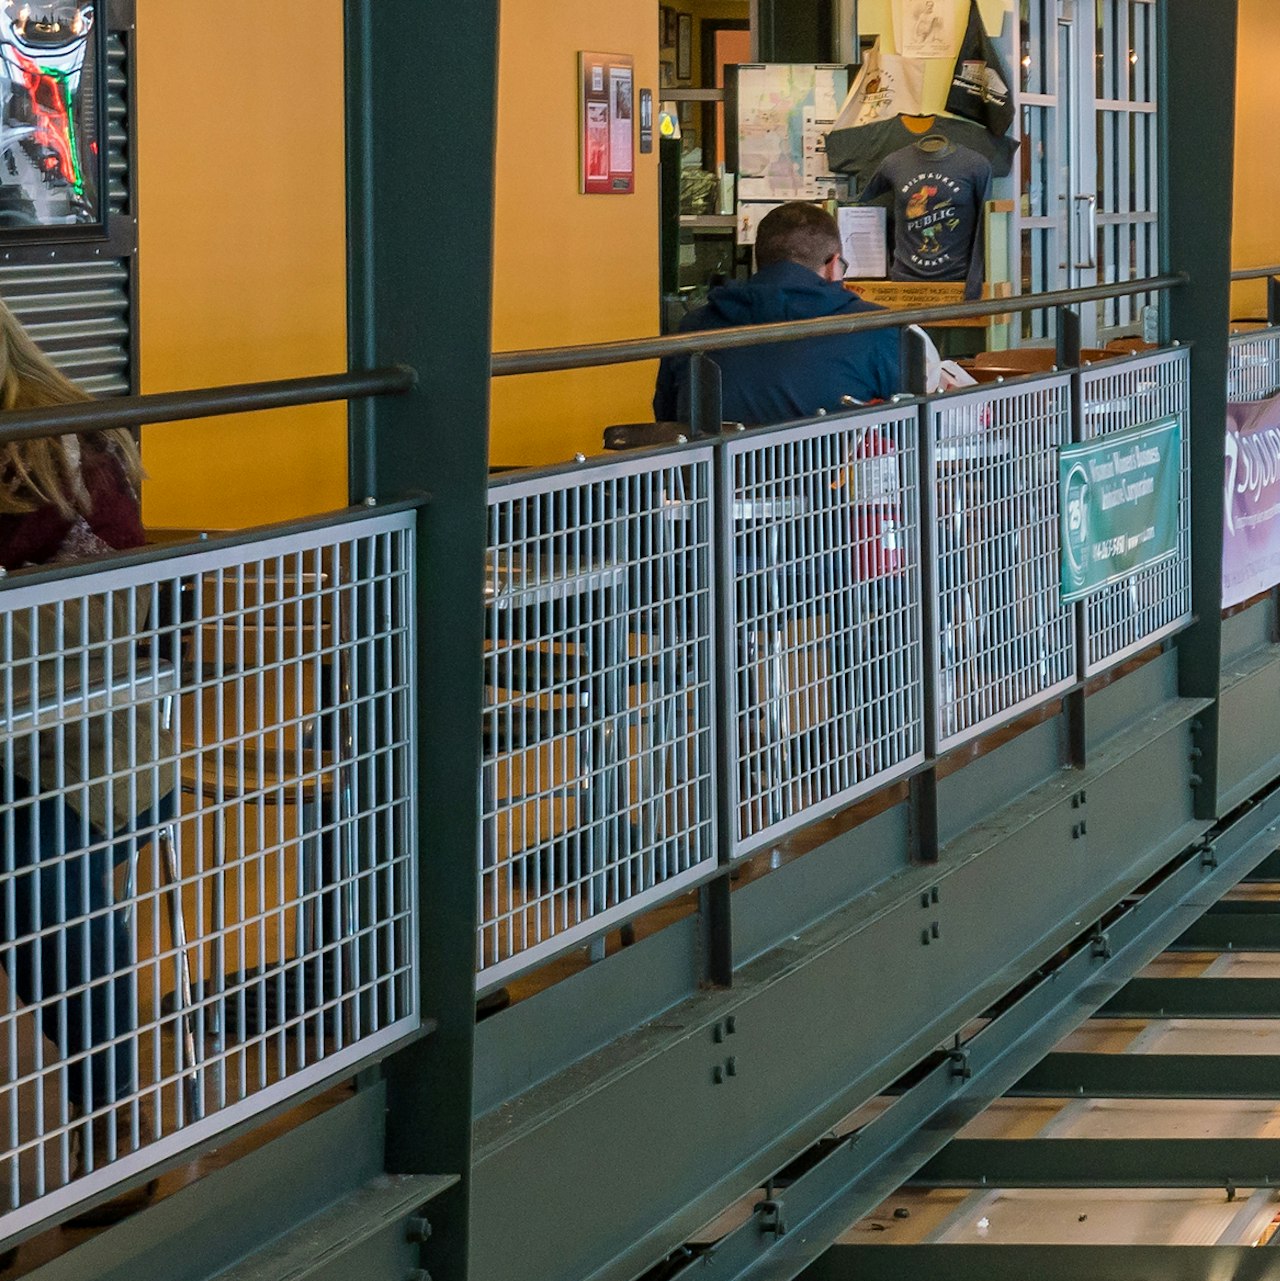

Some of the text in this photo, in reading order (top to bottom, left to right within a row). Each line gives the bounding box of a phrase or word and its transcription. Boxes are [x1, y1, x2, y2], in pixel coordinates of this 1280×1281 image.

[902, 172, 960, 193] MILWAUKEE
[907, 207, 956, 231] PUBLIC
[911, 254, 950, 267] MARKET
